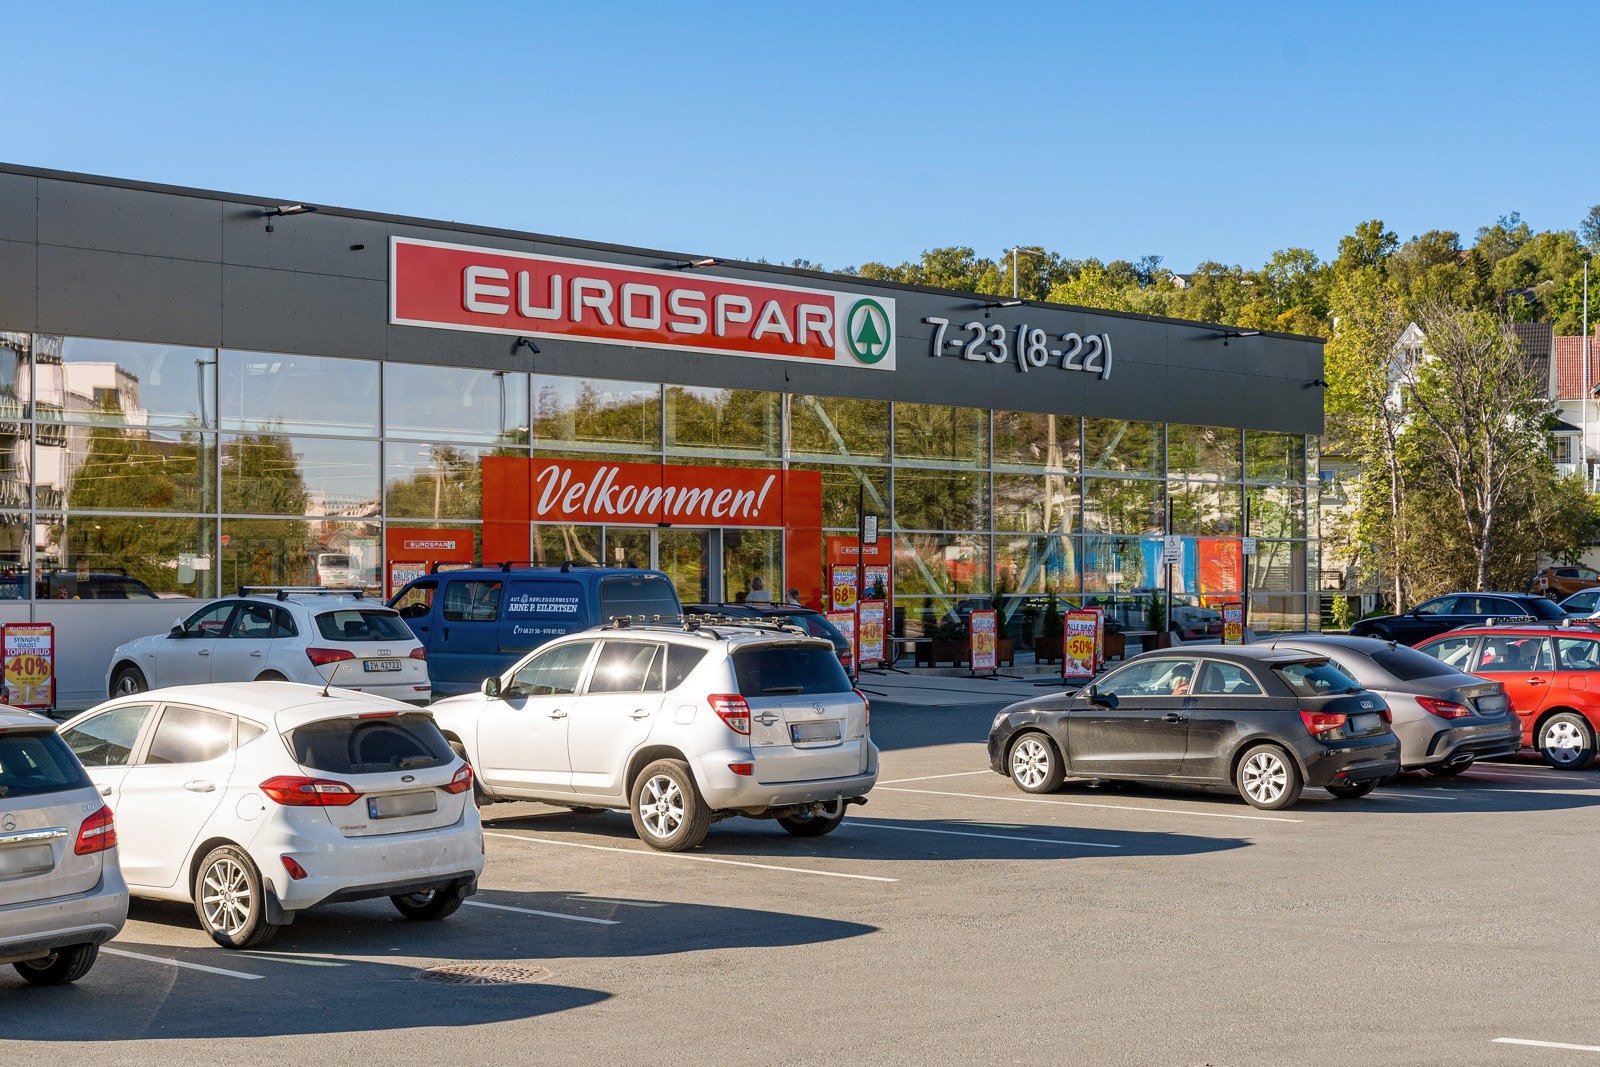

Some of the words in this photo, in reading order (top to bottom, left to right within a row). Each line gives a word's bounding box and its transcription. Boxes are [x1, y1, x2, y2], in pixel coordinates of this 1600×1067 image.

[463, 265, 833, 348] EUROSPAR
[926, 317, 1008, 364] 7-23
[1016, 323, 1112, 380] (8-22)
[536, 465, 776, 518] Velkommen!
[509, 603, 529, 611] ARNE
[536, 603, 578, 613] EILERTSEN
[1225, 621, 1241, 635] -50%
[7, 648, 50, 656] TOPPTILBUD
[1069, 639, 1092, 654] -50%
[5, 657, 48, 676] -40%
[381, 661, 399, 669] 42722
